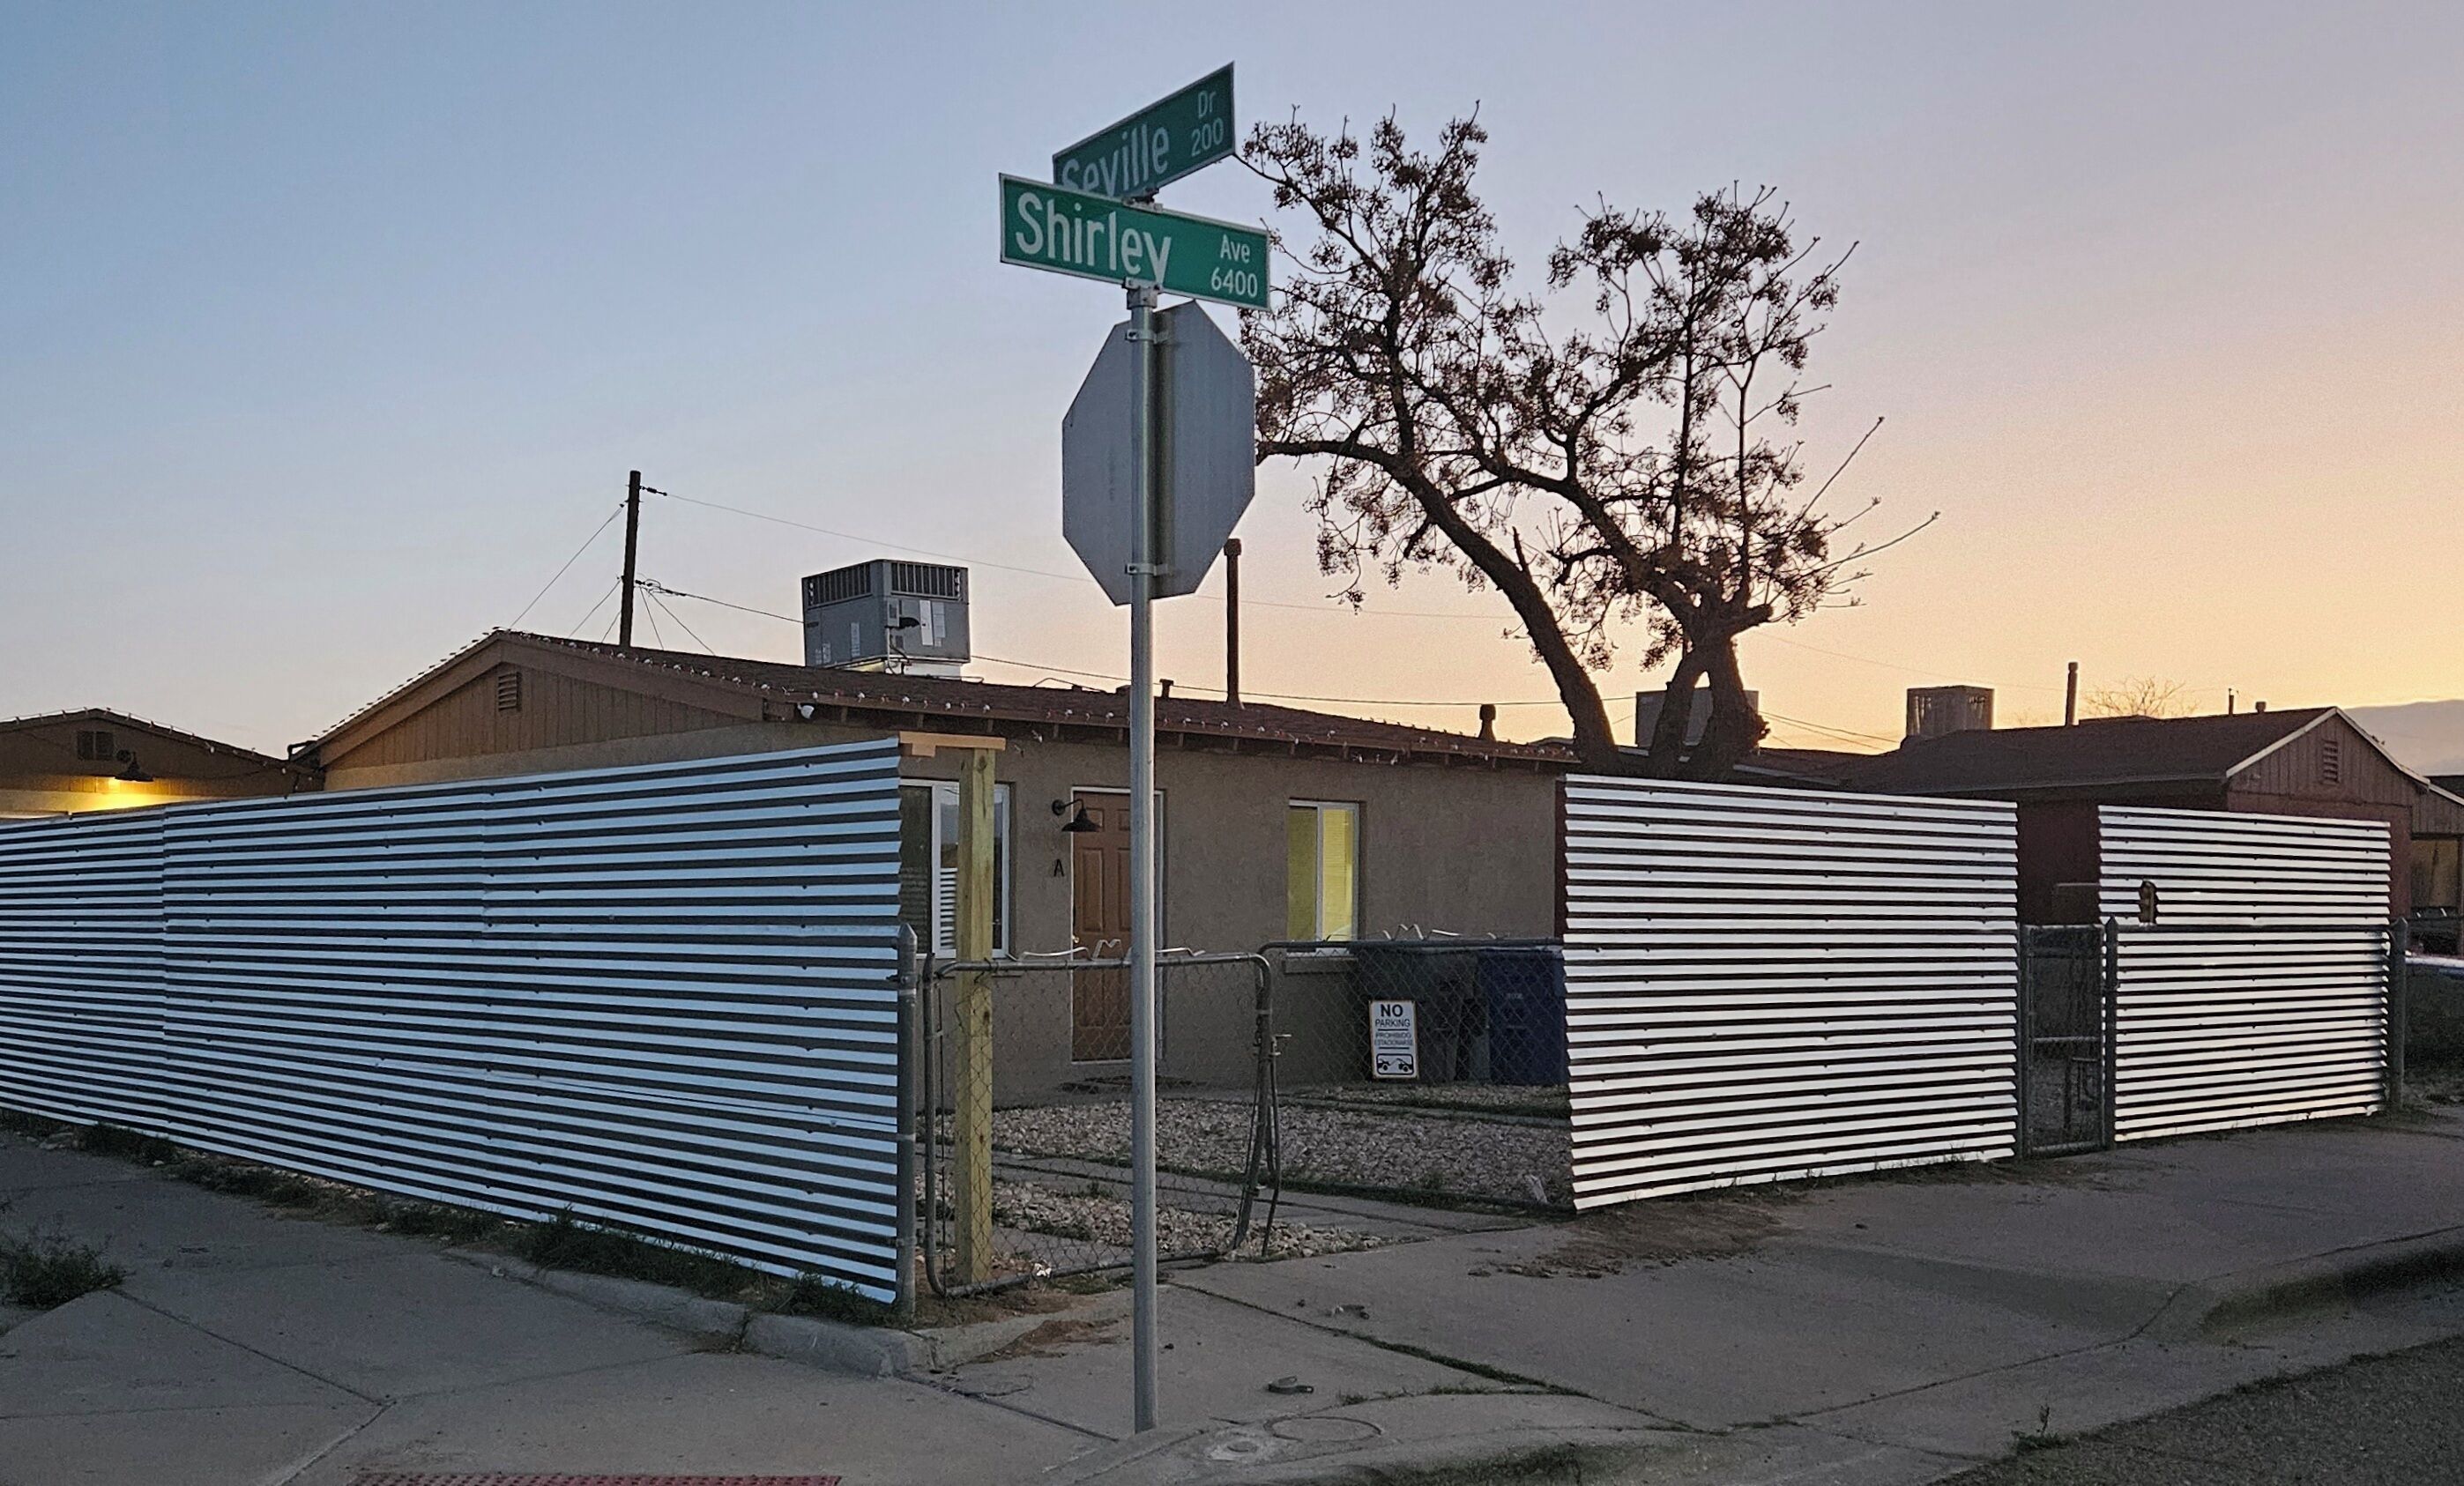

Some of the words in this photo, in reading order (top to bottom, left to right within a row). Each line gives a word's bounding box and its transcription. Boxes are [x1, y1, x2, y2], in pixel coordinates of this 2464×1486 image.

[1198, 90, 1217, 117] Dr
[1191, 118, 1225, 156] 200
[1061, 123, 1171, 197] Seville
[1016, 192, 1172, 286] Shirley
[1220, 234, 1251, 264] Ave
[1210, 266, 1259, 299] 6400
[1053, 858, 1065, 877] A
[1375, 1018, 1411, 1028] PARKING
[1381, 1004, 1403, 1017] NO
